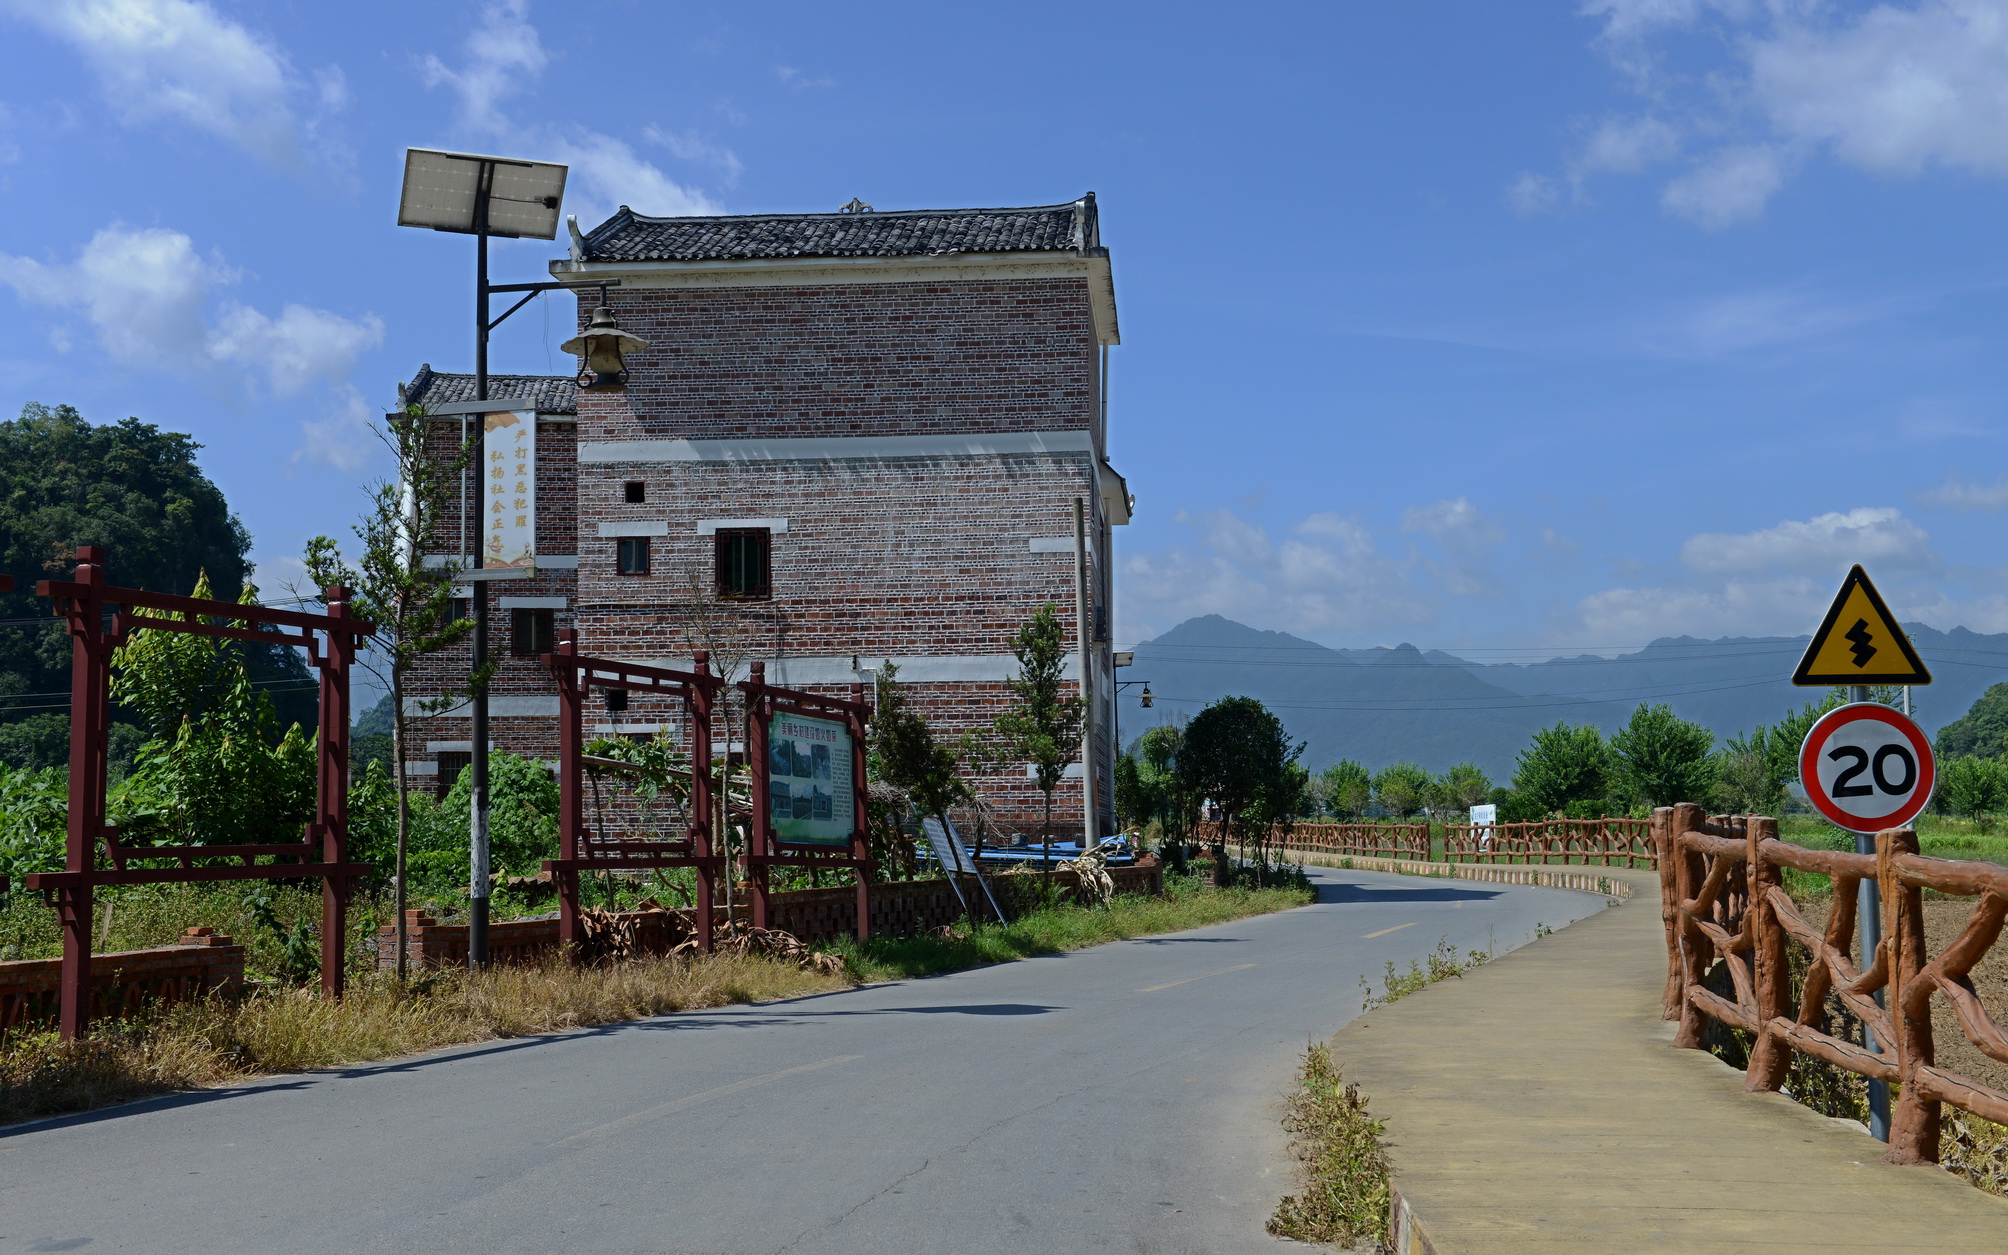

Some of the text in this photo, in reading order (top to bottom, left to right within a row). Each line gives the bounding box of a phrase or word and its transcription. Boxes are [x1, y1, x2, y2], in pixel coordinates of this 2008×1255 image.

[490, 450, 506, 550] 弘扬社会正气
[514, 429, 528, 528] 严打黑恶犯罪
[1827, 744, 1917, 798] 20
